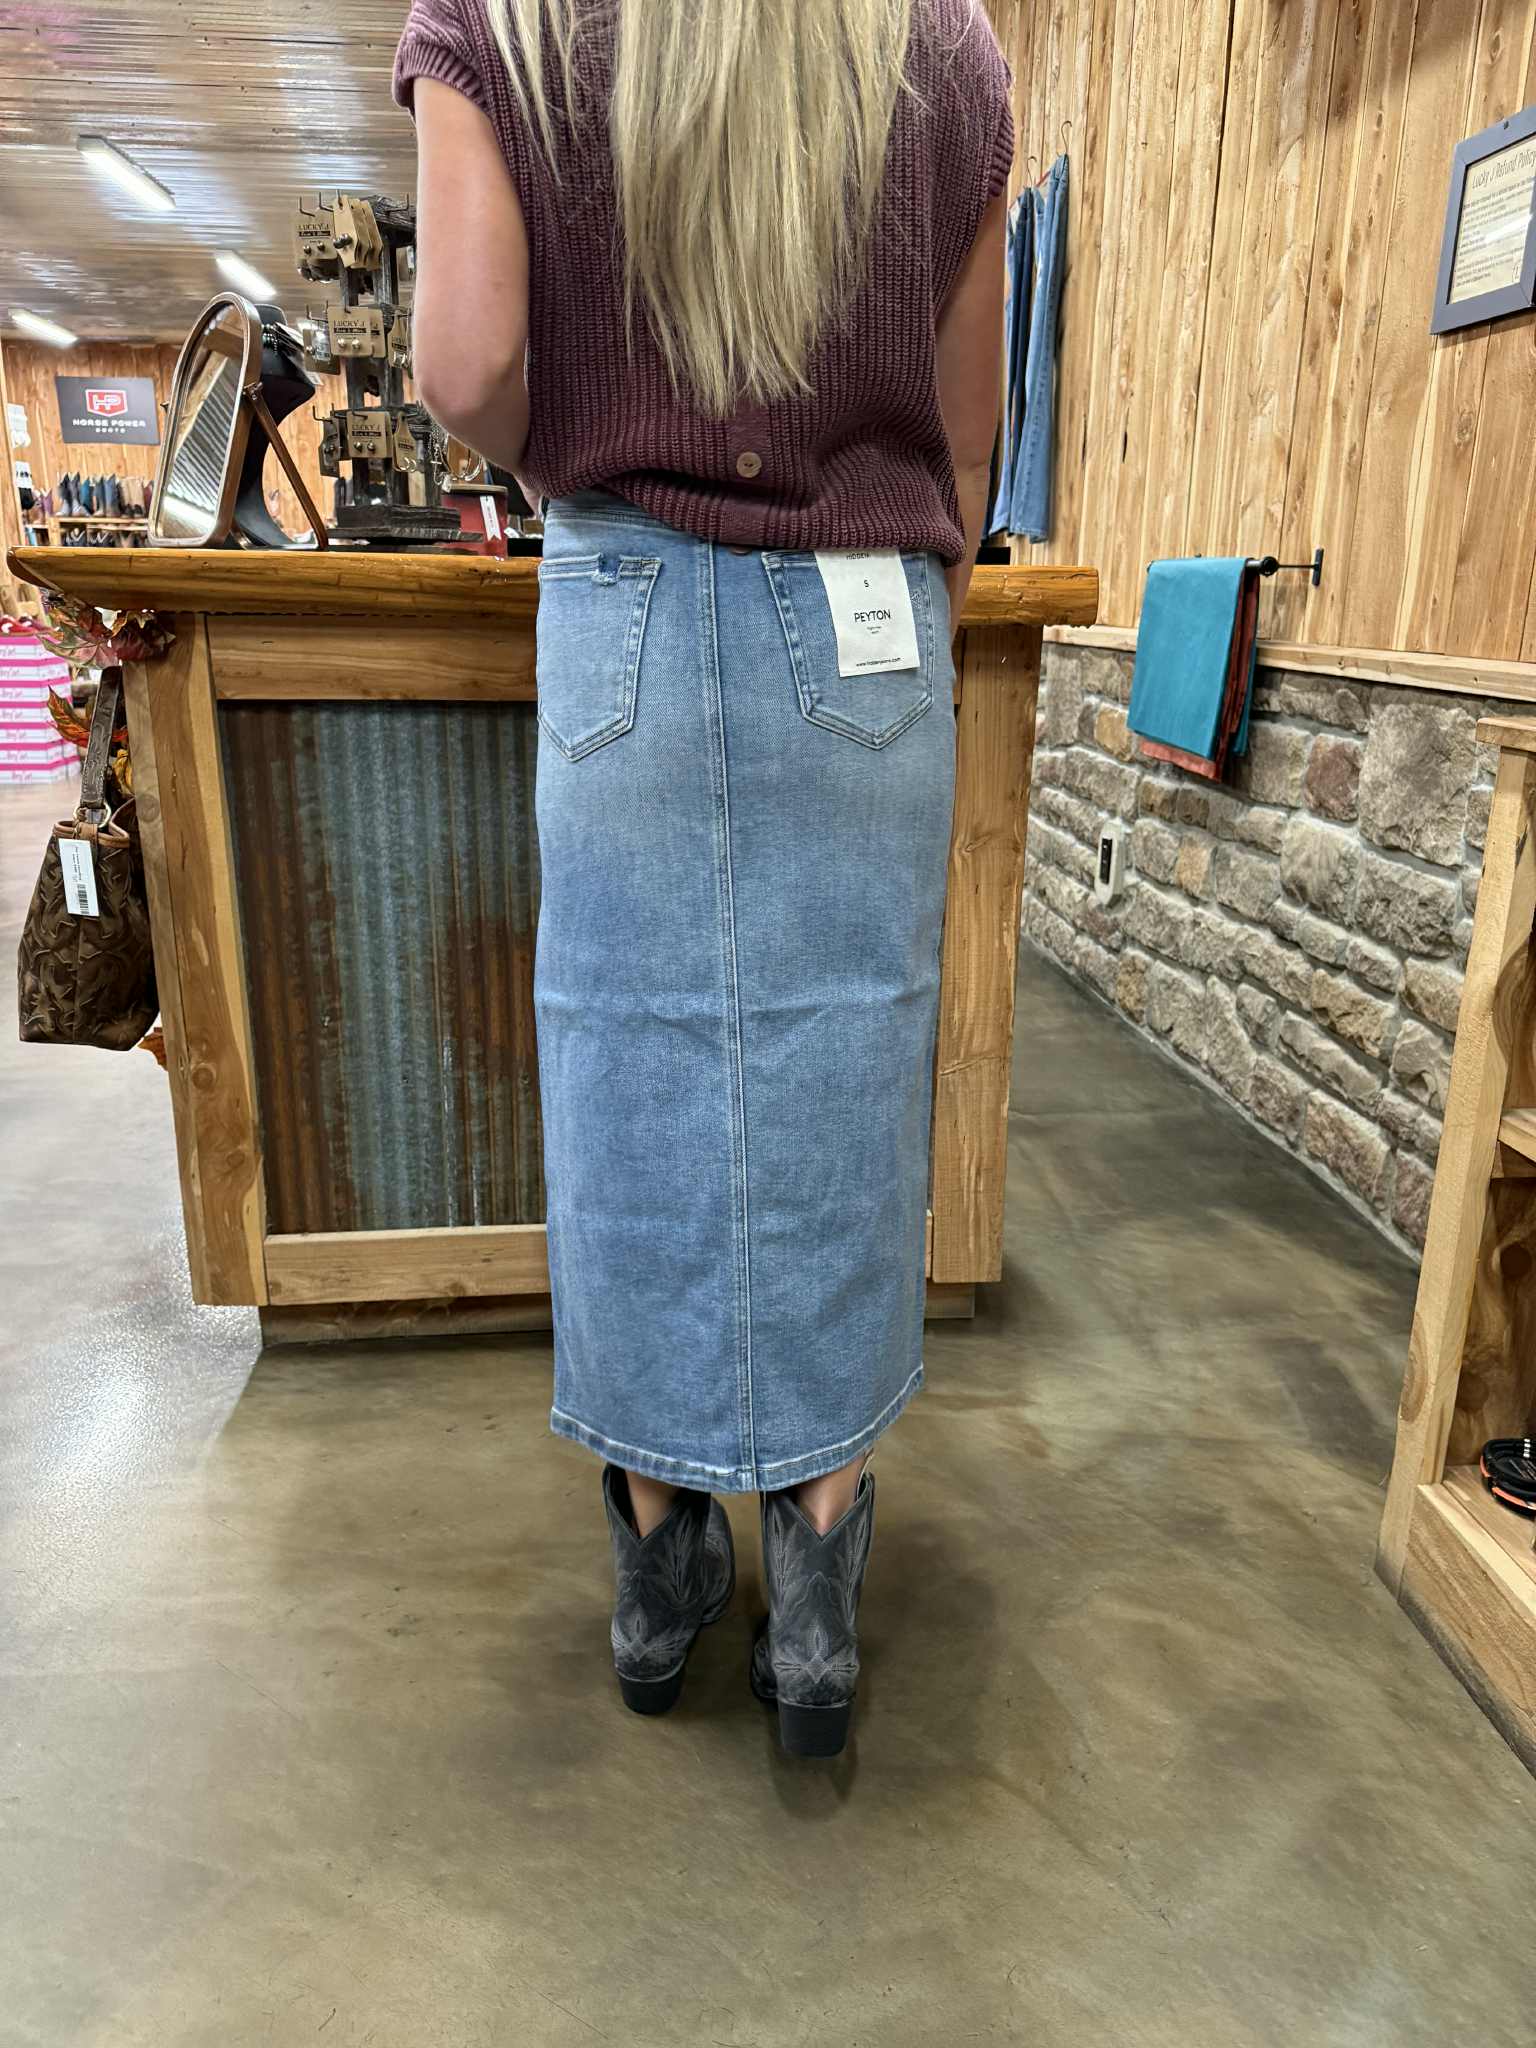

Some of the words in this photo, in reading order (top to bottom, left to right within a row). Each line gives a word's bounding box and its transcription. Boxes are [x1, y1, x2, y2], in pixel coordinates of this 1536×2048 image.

[1471, 170, 1490, 189] Lucky
[72, 418, 109, 427] HORSE
[111, 418, 147, 428] POWER
[863, 579, 870, 588] S
[853, 608, 892, 624] PEYTON
